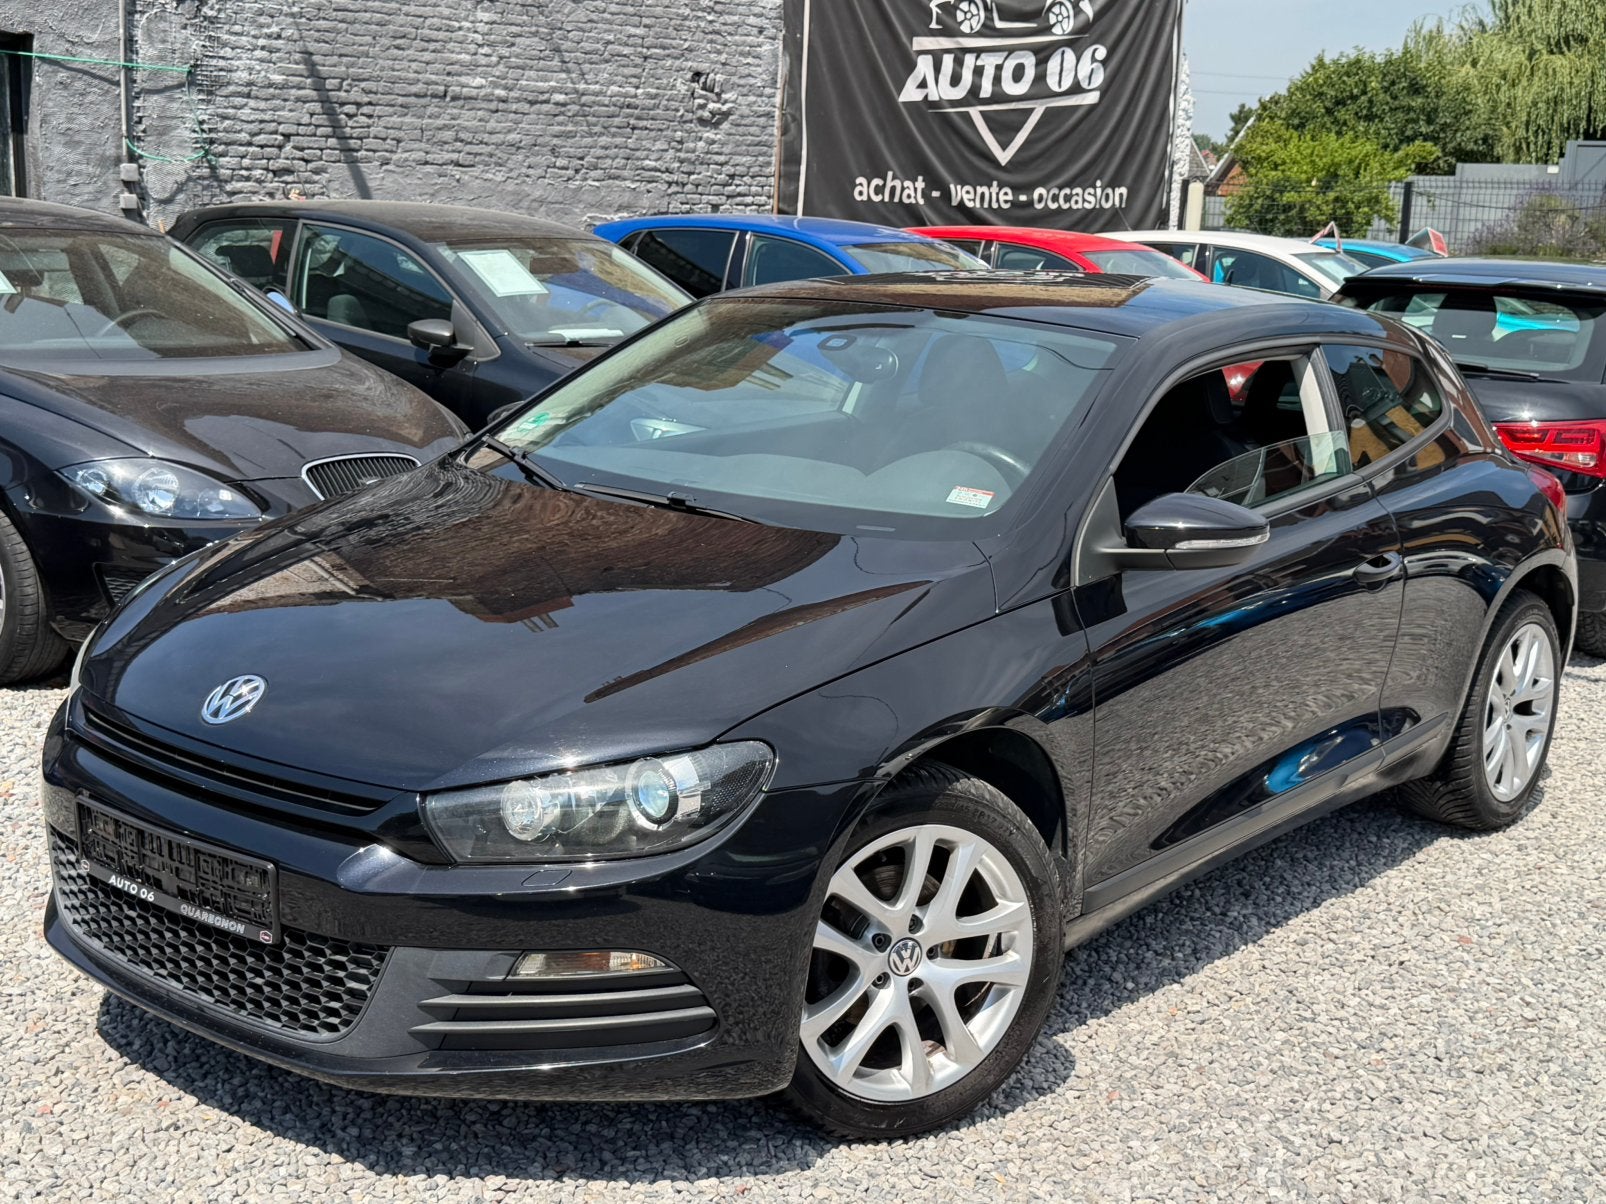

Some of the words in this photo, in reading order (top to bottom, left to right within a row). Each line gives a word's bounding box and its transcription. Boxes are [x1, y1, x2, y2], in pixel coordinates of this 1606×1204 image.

[898, 50, 1036, 102] AUTO
[1046, 44, 1106, 93] 06
[853, 171, 925, 205] achat
[949, 181, 1014, 209] vente
[1033, 180, 1127, 209] occasion
[108, 874, 138, 894] AUTO
[140, 888, 155, 902] 06
